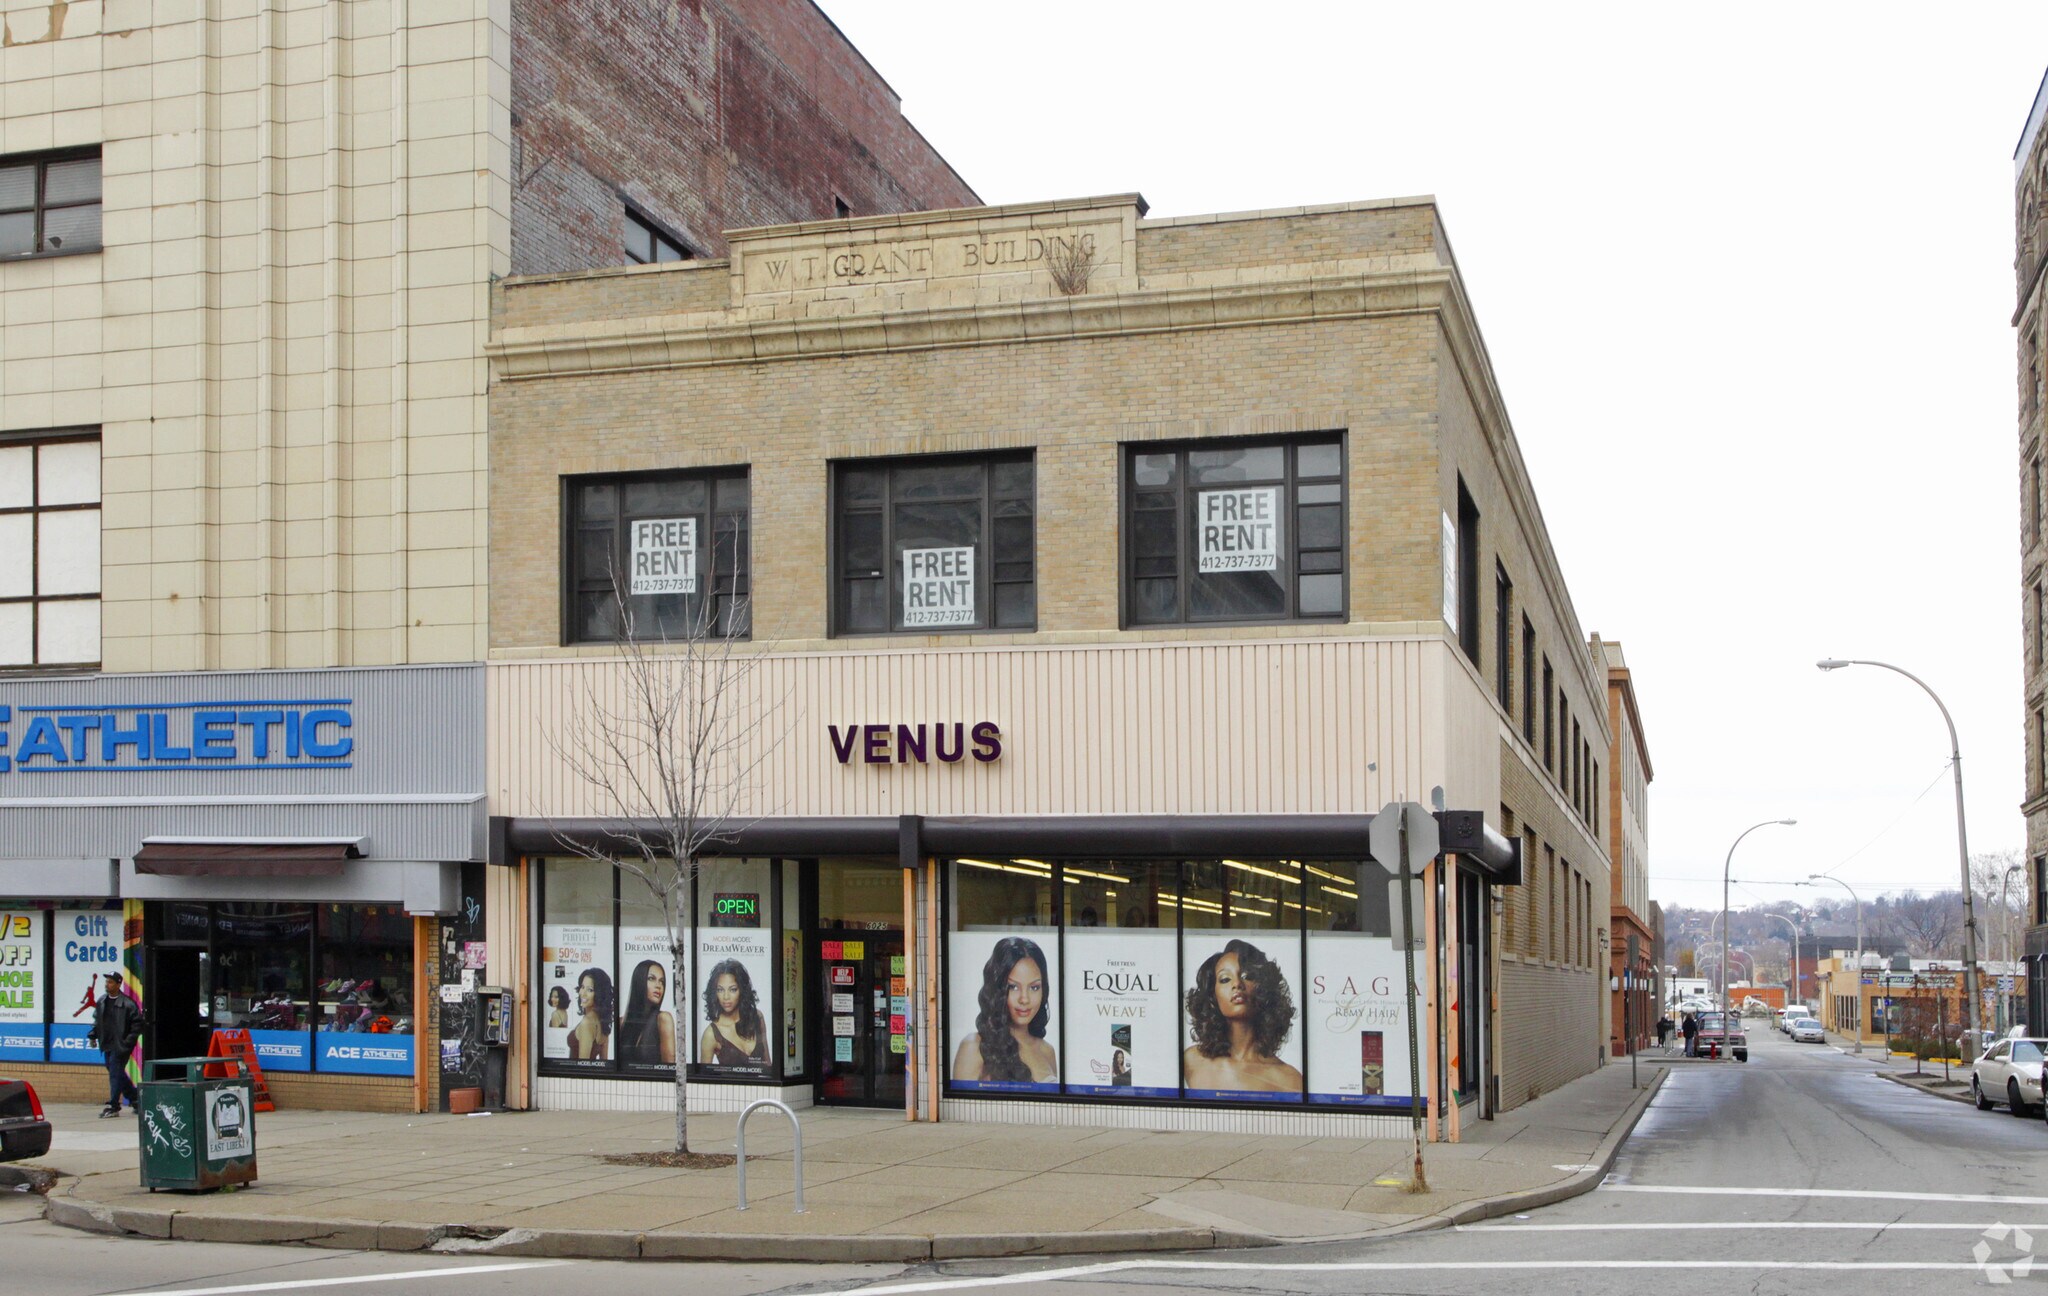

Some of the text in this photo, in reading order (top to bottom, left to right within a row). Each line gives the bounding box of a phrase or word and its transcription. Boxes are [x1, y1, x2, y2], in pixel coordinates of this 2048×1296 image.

[833, 247, 931, 278] GRANT
[963, 233, 1096, 268] BUILDING
[1206, 491, 1270, 522] FREE
[637, 521, 691, 549] FREE
[1204, 523, 1273, 552] RENT
[635, 549, 693, 576] RENT
[910, 550, 969, 578] FREE
[1200, 553, 1275, 569] 412-737-7377
[632, 578, 695, 592] 412-737-7377
[908, 579, 971, 608] RENT
[905, 609, 974, 624] 412-737-7377
[15, 709, 353, 763] ATHLETIC
[828, 721, 1003, 764] VENUS
[717, 899, 755, 915] OPEN
[866, 922, 888, 931] 6025
[0, 945, 32, 966] FF
[65, 941, 118, 962] Cards
[559, 948, 580, 959] 50%
[624, 942, 673, 953] DREAMWEA
[703, 943, 765, 954] DREAMWEAVER
[837, 968, 849, 976] HELP
[1083, 970, 1160, 995] EQUAL
[1096, 1003, 1146, 1018] WEAVE
[1335, 1007, 1397, 1018] REMY HAIR
[52, 1038, 84, 1049] ACE
[258, 1046, 302, 1055] ATHLETIC
[326, 1047, 408, 1058] ACE ATHLETIC
[210, 1143, 224, 1153] EAST
